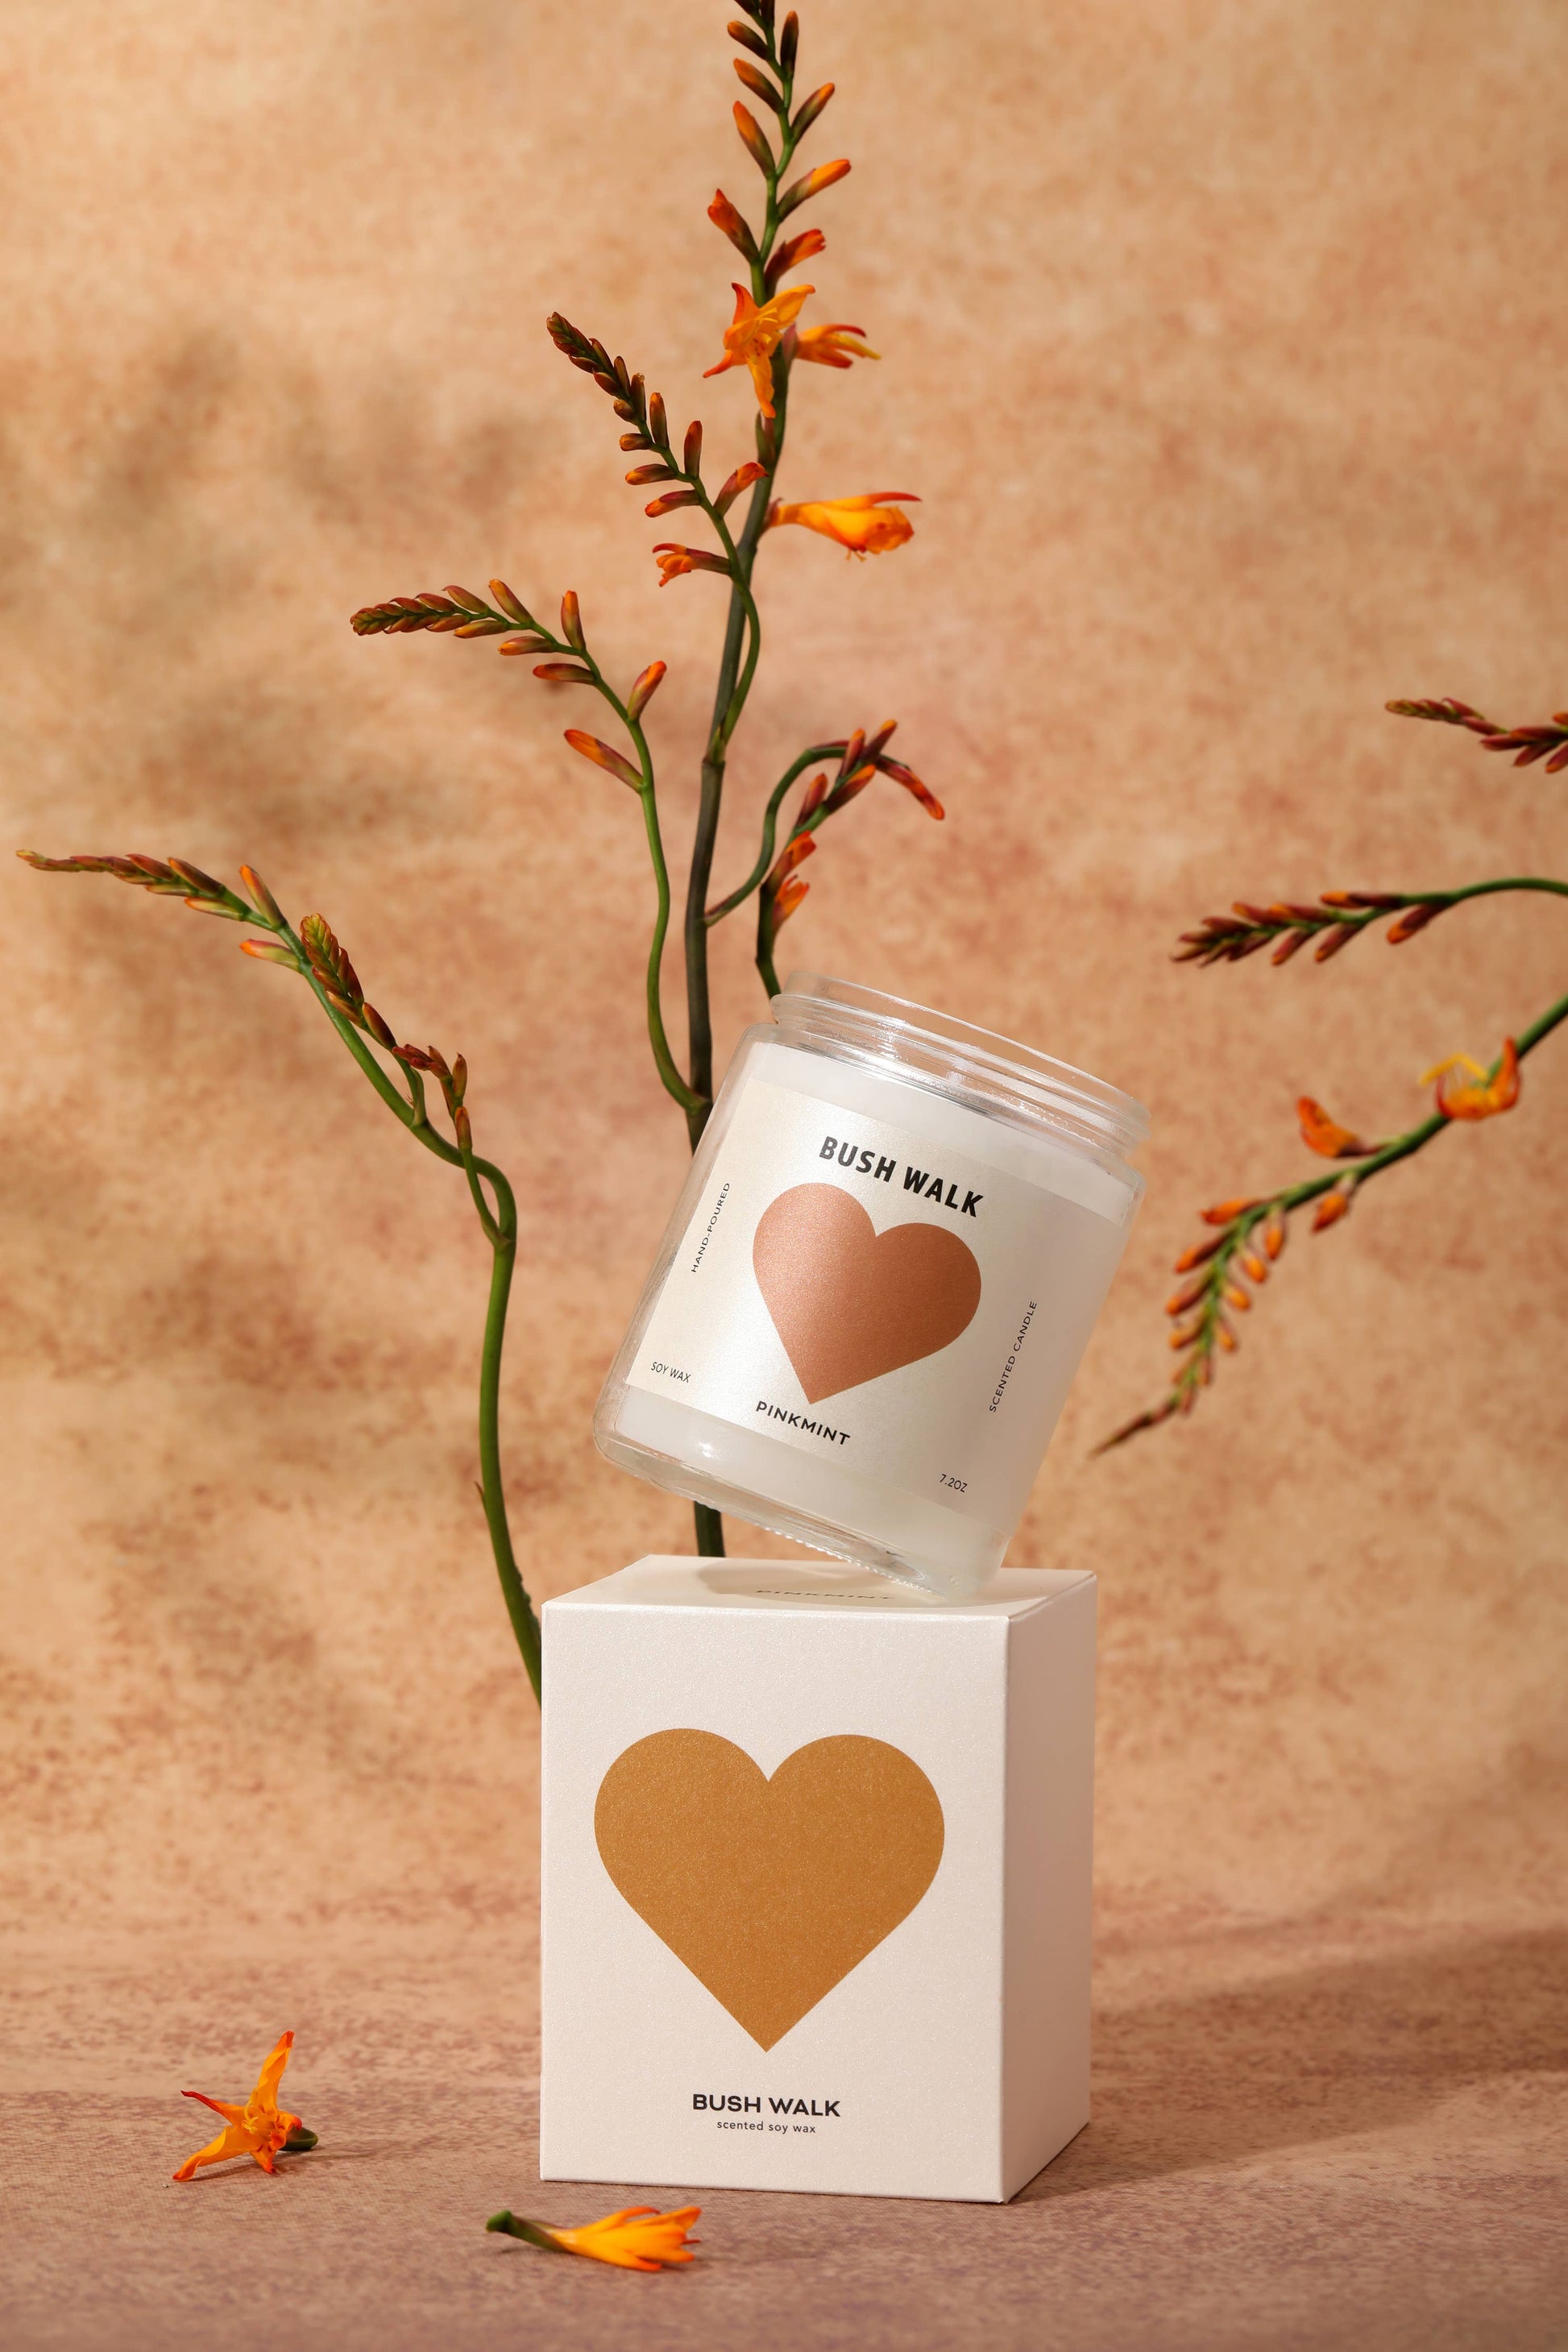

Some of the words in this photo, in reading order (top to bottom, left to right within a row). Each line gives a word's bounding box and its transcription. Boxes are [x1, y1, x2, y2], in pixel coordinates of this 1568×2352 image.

[819, 1135, 897, 1183] BUSH
[902, 1166, 984, 1218] WALK
[691, 1183, 730, 1273] HAND-POURED
[650, 1361, 669, 1375] SOY
[670, 1367, 691, 1383] WAX
[989, 1355, 1016, 1412] SCENTED
[1013, 1300, 1037, 1352] CANDLE
[756, 1400, 851, 1445] PINKMINT
[940, 1473, 968, 1493] 7.2OZ
[693, 2093, 761, 2113] BUSH
[768, 2097, 841, 2118] WALK
[716, 2121, 764, 2131] scented
[768, 2124, 789, 2134] soy
[793, 2126, 816, 2134] wax
